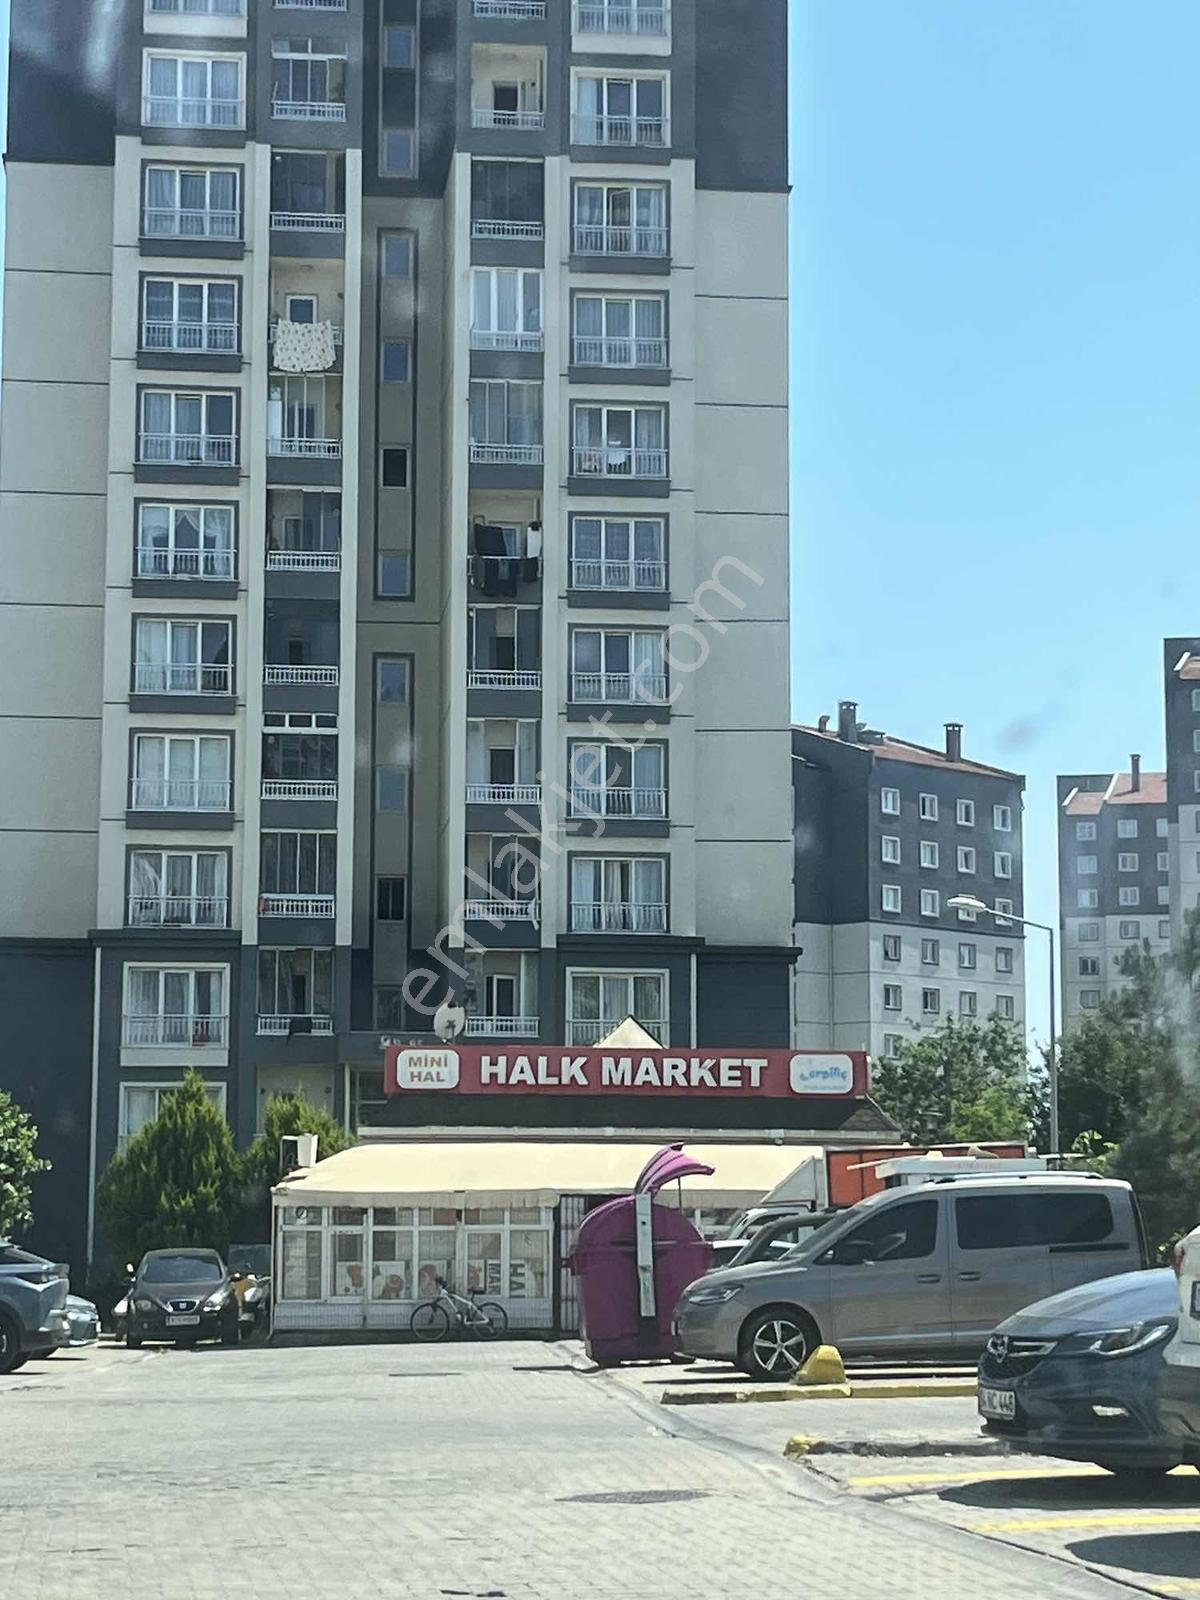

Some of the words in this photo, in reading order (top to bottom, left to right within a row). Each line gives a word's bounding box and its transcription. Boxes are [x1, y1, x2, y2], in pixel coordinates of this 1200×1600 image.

[408, 1053, 449, 1068] MİNİ
[410, 1071, 447, 1083] HAL
[480, 1055, 590, 1086] HALK
[601, 1056, 769, 1088] MARKET
